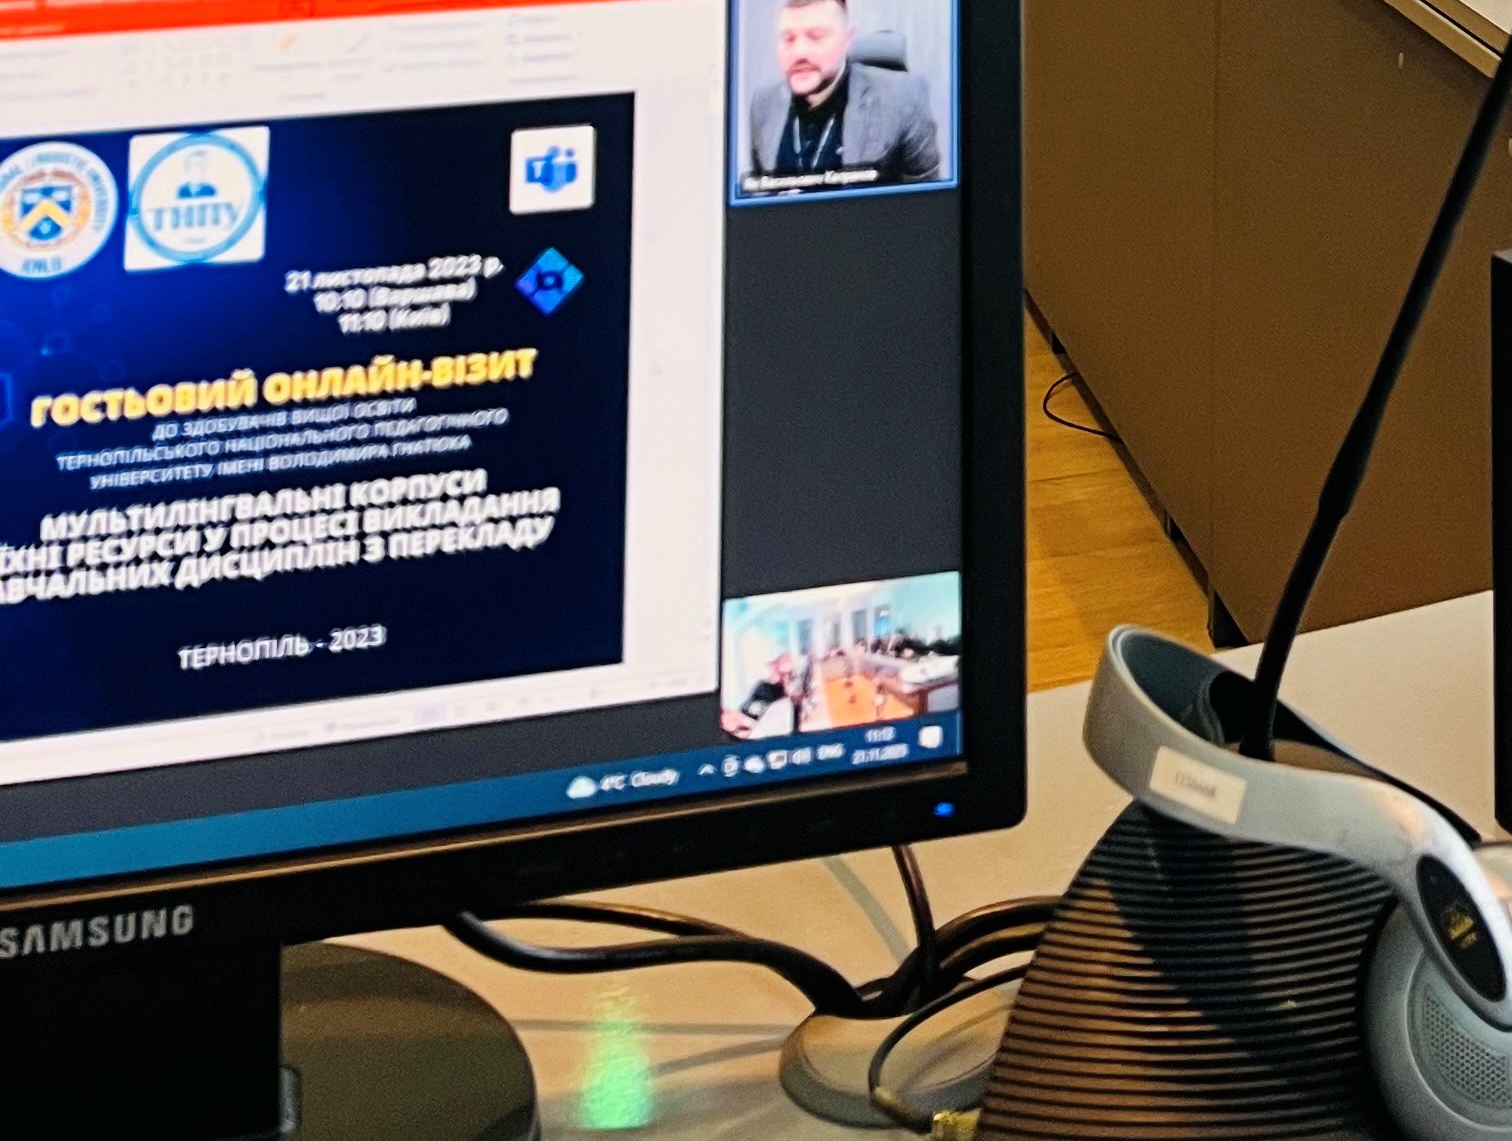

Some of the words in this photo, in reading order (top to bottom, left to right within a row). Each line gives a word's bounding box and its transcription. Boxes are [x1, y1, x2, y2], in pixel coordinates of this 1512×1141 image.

[427, 254, 482, 280] 2023
[30, 368, 259, 428] ГОСТЬОВИЙ
[262, 348, 539, 406] ОНЛАЙН-ВІЗИТ
[56, 438, 220, 471] ТЕРНОПІЛЬСЬКОГО
[152, 422, 179, 442] ДО
[89, 462, 214, 491] УНІВЕРСИТЕТУ
[217, 455, 265, 477] ІМЕНІ
[40, 482, 347, 542] МУЛЬТИЛІНГВАЛЬНІ
[350, 467, 488, 508] КОРПУСИ
[66, 527, 201, 568] РЕСУРСИ
[203, 522, 228, 553] У
[230, 510, 360, 550] ПРОЦЕСІ
[362, 486, 562, 535] ВИКЛАДАННЯ
[174, 538, 361, 591] ДИСЦИПЛІН
[361, 534, 386, 563] З
[387, 514, 556, 560] ПЕРЕКЛАДУ
[177, 634, 313, 671] ТЕРНОПІЛЬ
[328, 623, 387, 653] 2023
[0, 905, 194, 958] SAMSUNG
